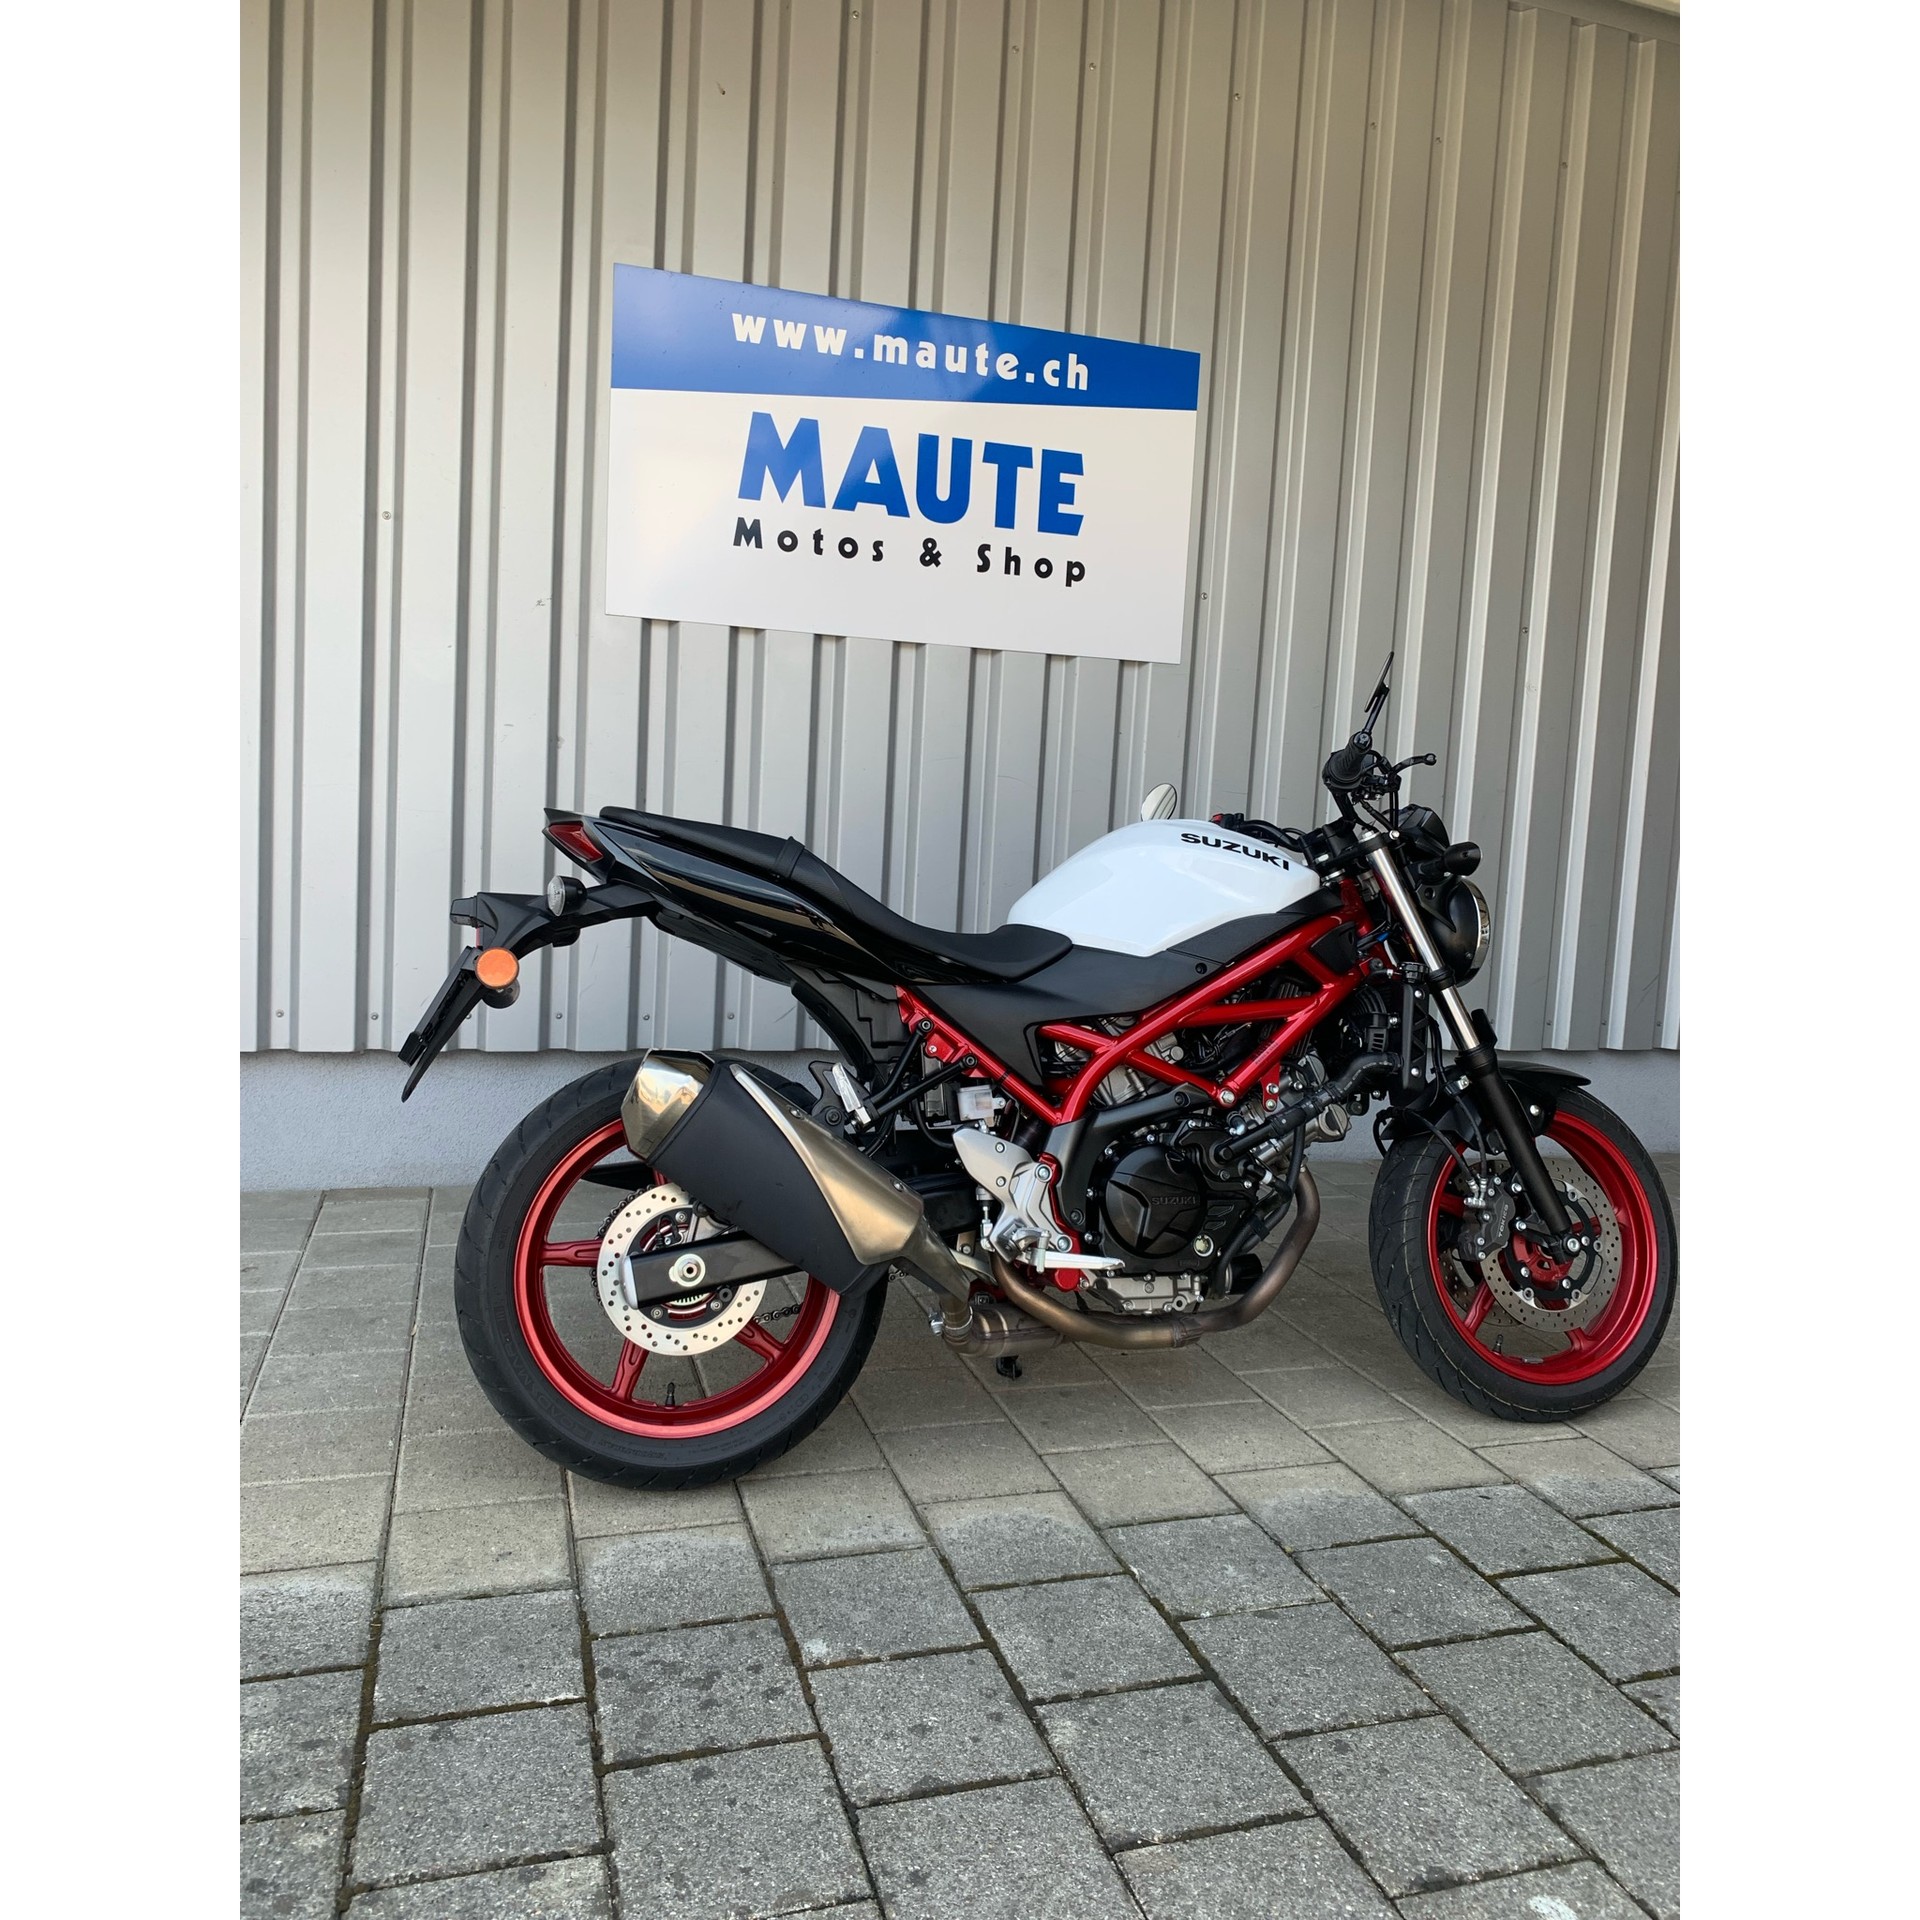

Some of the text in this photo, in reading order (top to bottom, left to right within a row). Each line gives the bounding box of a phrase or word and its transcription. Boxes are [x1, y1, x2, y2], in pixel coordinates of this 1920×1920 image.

[731, 313, 1090, 391] www.maute.ch
[738, 411, 1085, 537] MAUTE
[732, 517, 1086, 588] Motos & Shop
[1181, 833, 1290, 871] SUZUKI
[1151, 1195, 1196, 1206] SUZUKI
